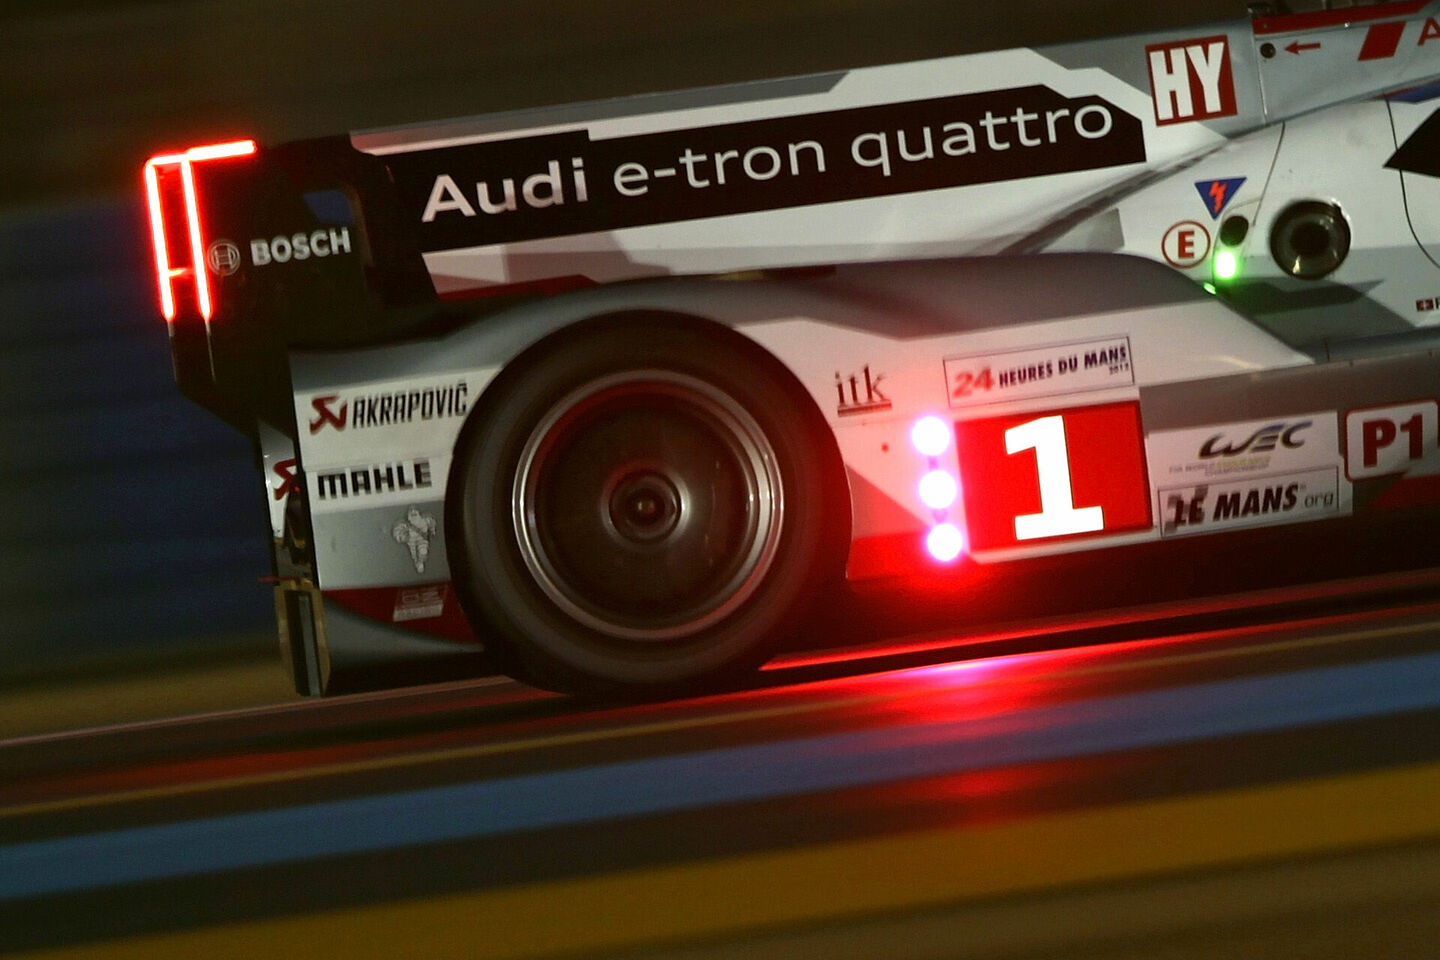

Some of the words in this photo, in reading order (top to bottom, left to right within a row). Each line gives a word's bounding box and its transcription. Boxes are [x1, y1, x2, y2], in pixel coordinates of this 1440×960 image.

[1150, 40, 1228, 121] HY
[421, 155, 590, 223] Audi
[612, 137, 828, 198] e-tron
[849, 103, 1115, 176] quattro
[250, 226, 351, 266] BOSCH
[1177, 231, 1196, 258] E
[835, 363, 891, 407] itk
[953, 365, 993, 399] 24
[999, 362, 1054, 389] HEURES
[1058, 354, 1079, 374] DU
[1084, 345, 1127, 369] MANS
[1199, 420, 1313, 459] WEC
[1362, 413, 1424, 467] P1
[317, 458, 433, 499] MAHLE
[1002, 414, 1105, 541] 1
[1213, 483, 1299, 522] MANS
